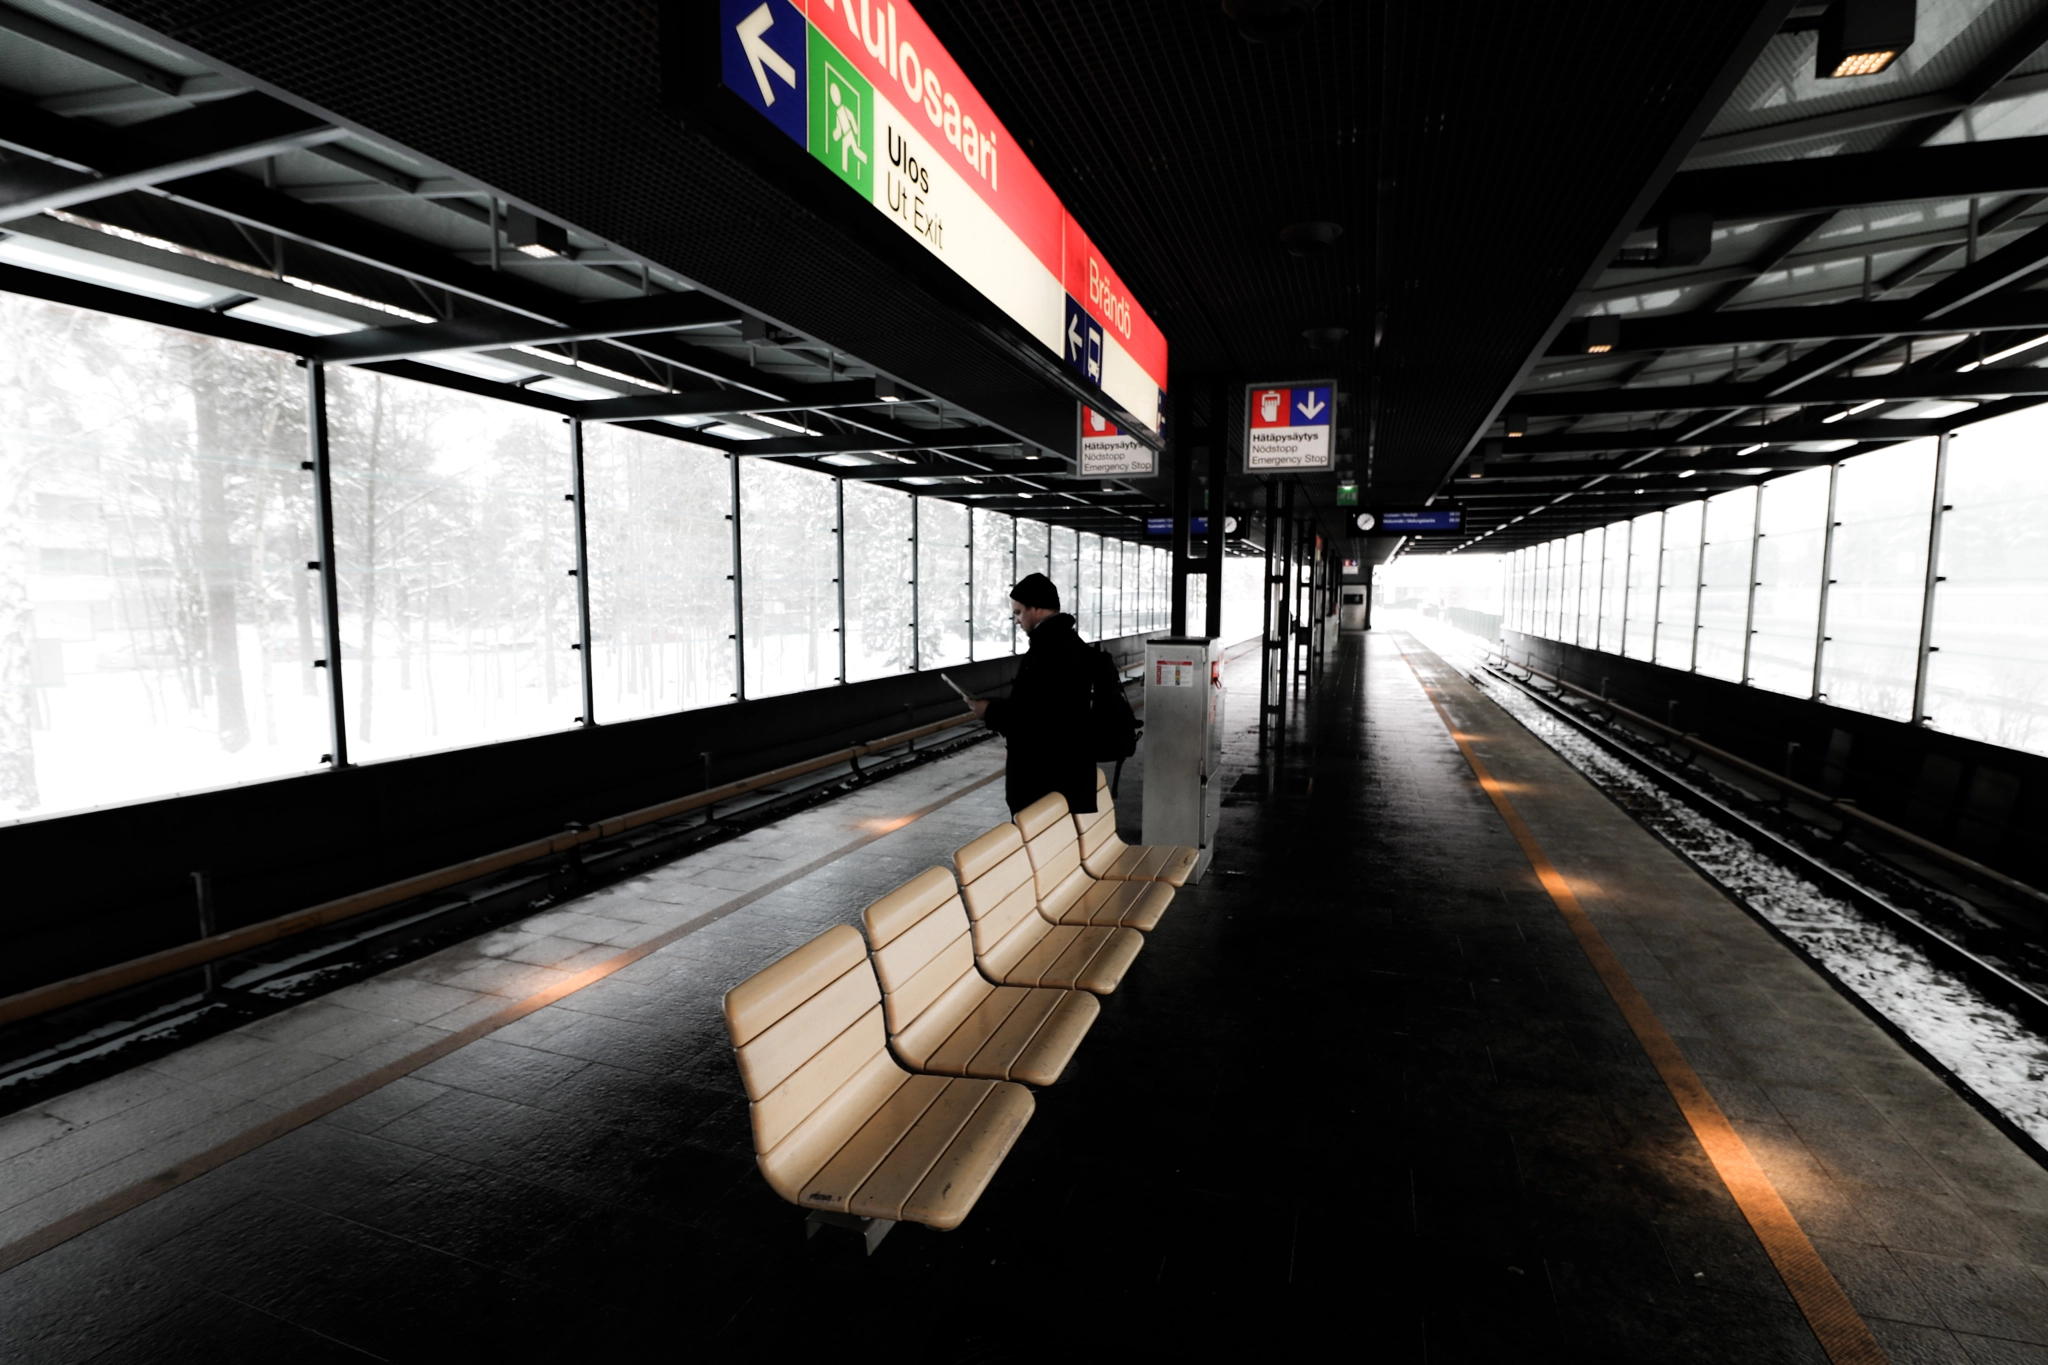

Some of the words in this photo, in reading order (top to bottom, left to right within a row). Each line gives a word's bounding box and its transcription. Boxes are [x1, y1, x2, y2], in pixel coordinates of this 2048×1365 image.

[822, 0, 997, 192] ulosaari
[888, 124, 929, 194] Ulos
[887, 170, 907, 221] Ut
[914, 195, 943, 250] Exit
[1089, 255, 1132, 340] Brändö
[1252, 432, 1319, 444] Hätäpysäytys
[1252, 445, 1298, 454] Nödstopp
[1084, 452, 1126, 462] Nödstopp
[1252, 455, 1303, 466] Emergency
[1304, 454, 1327, 464] Stop
[1084, 462, 1129, 473] Emergency
[1131, 461, 1152, 472] Stop
